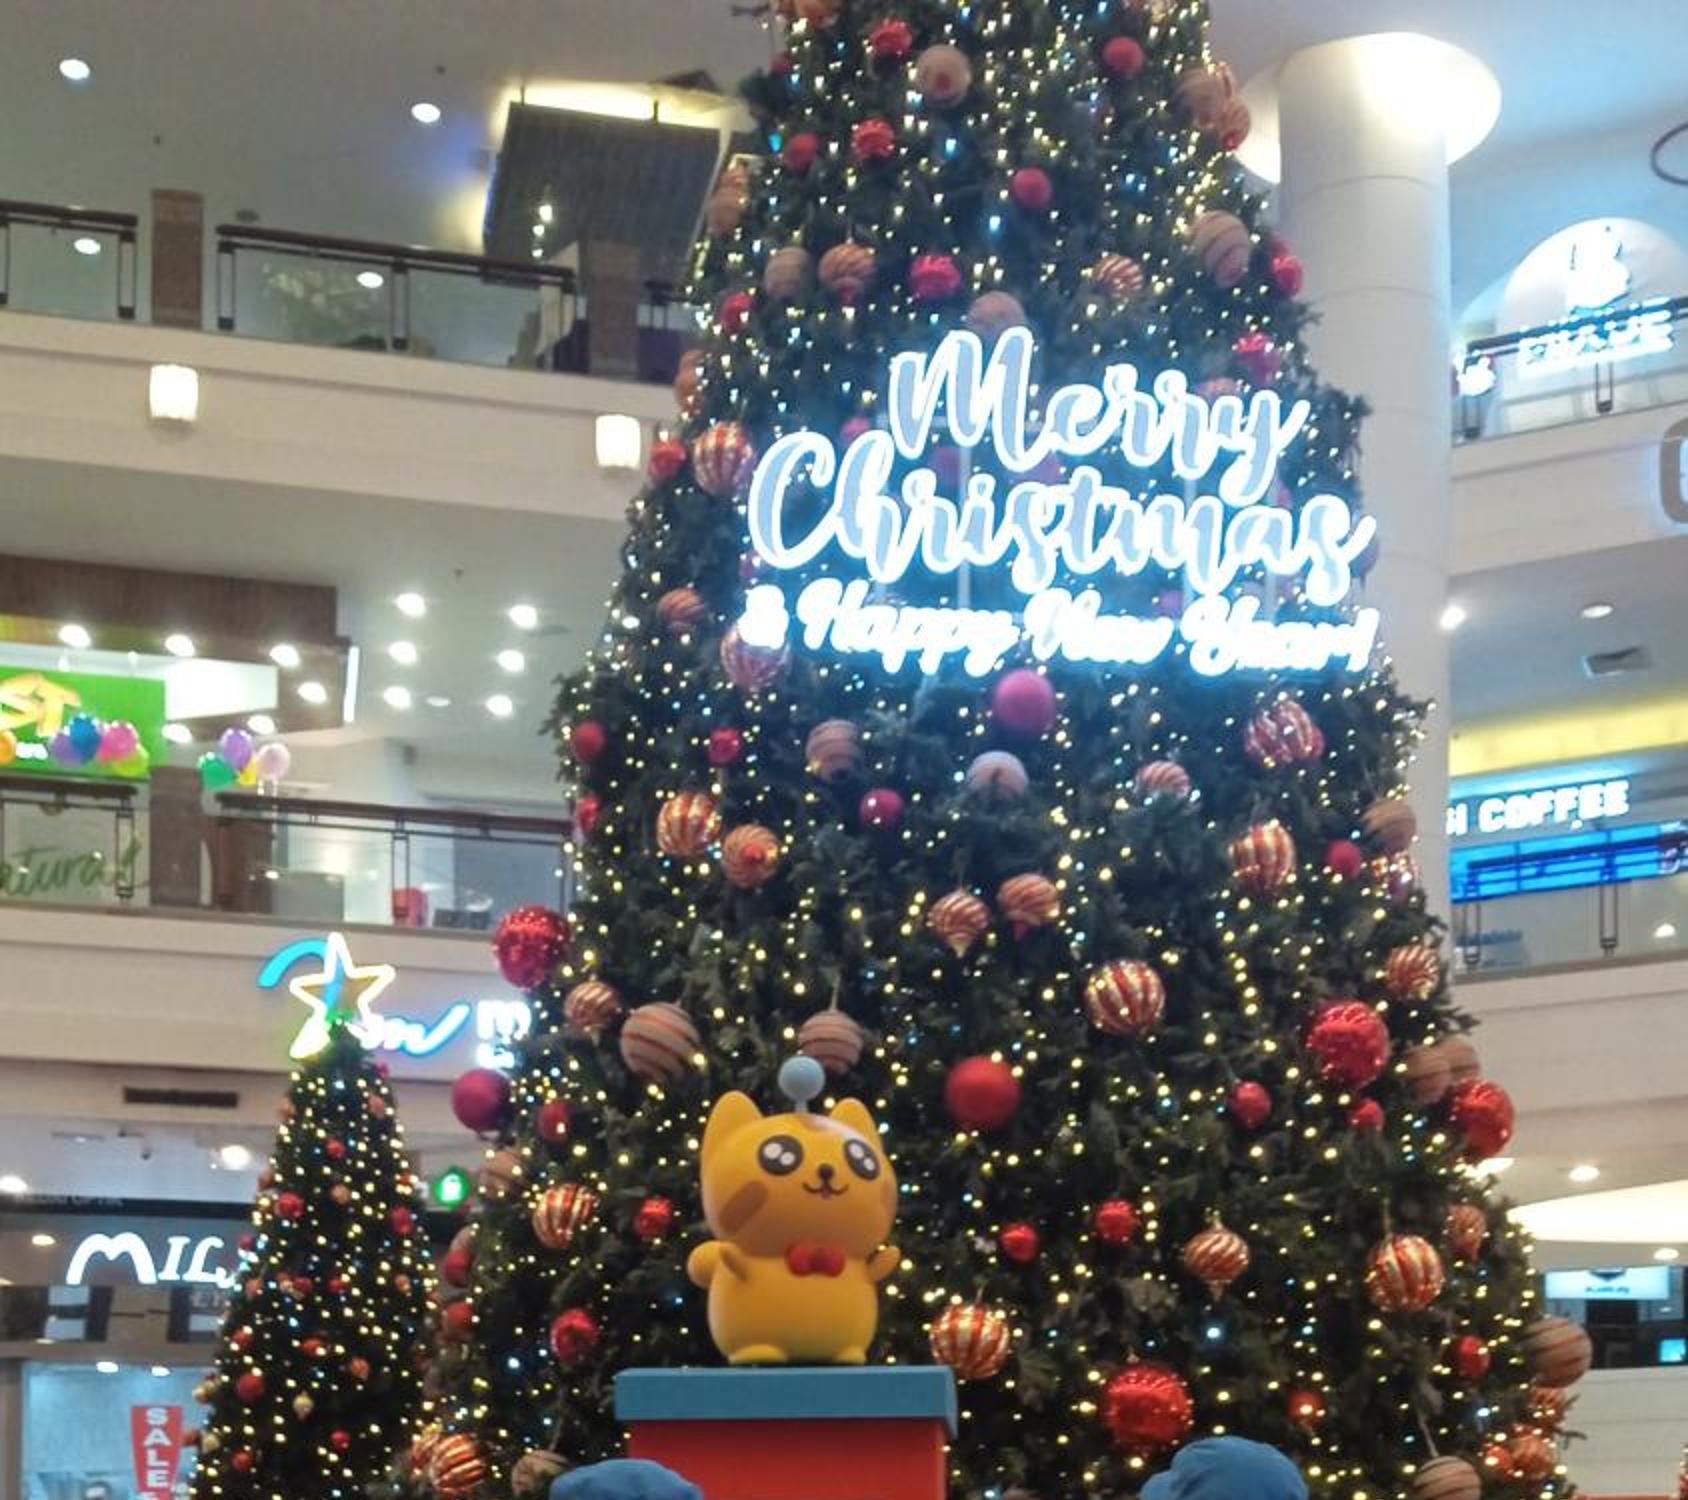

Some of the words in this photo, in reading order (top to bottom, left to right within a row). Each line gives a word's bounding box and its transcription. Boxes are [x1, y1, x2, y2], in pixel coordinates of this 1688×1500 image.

[889, 325, 1311, 506] Merry
[747, 431, 1377, 605] Christmas
[737, 584, 789, 649] &
[796, 576, 1021, 677] Happy
[1022, 588, 1174, 665] New
[1478, 779, 1630, 833] COFFEE
[143, 1407, 172, 1488] SALE
